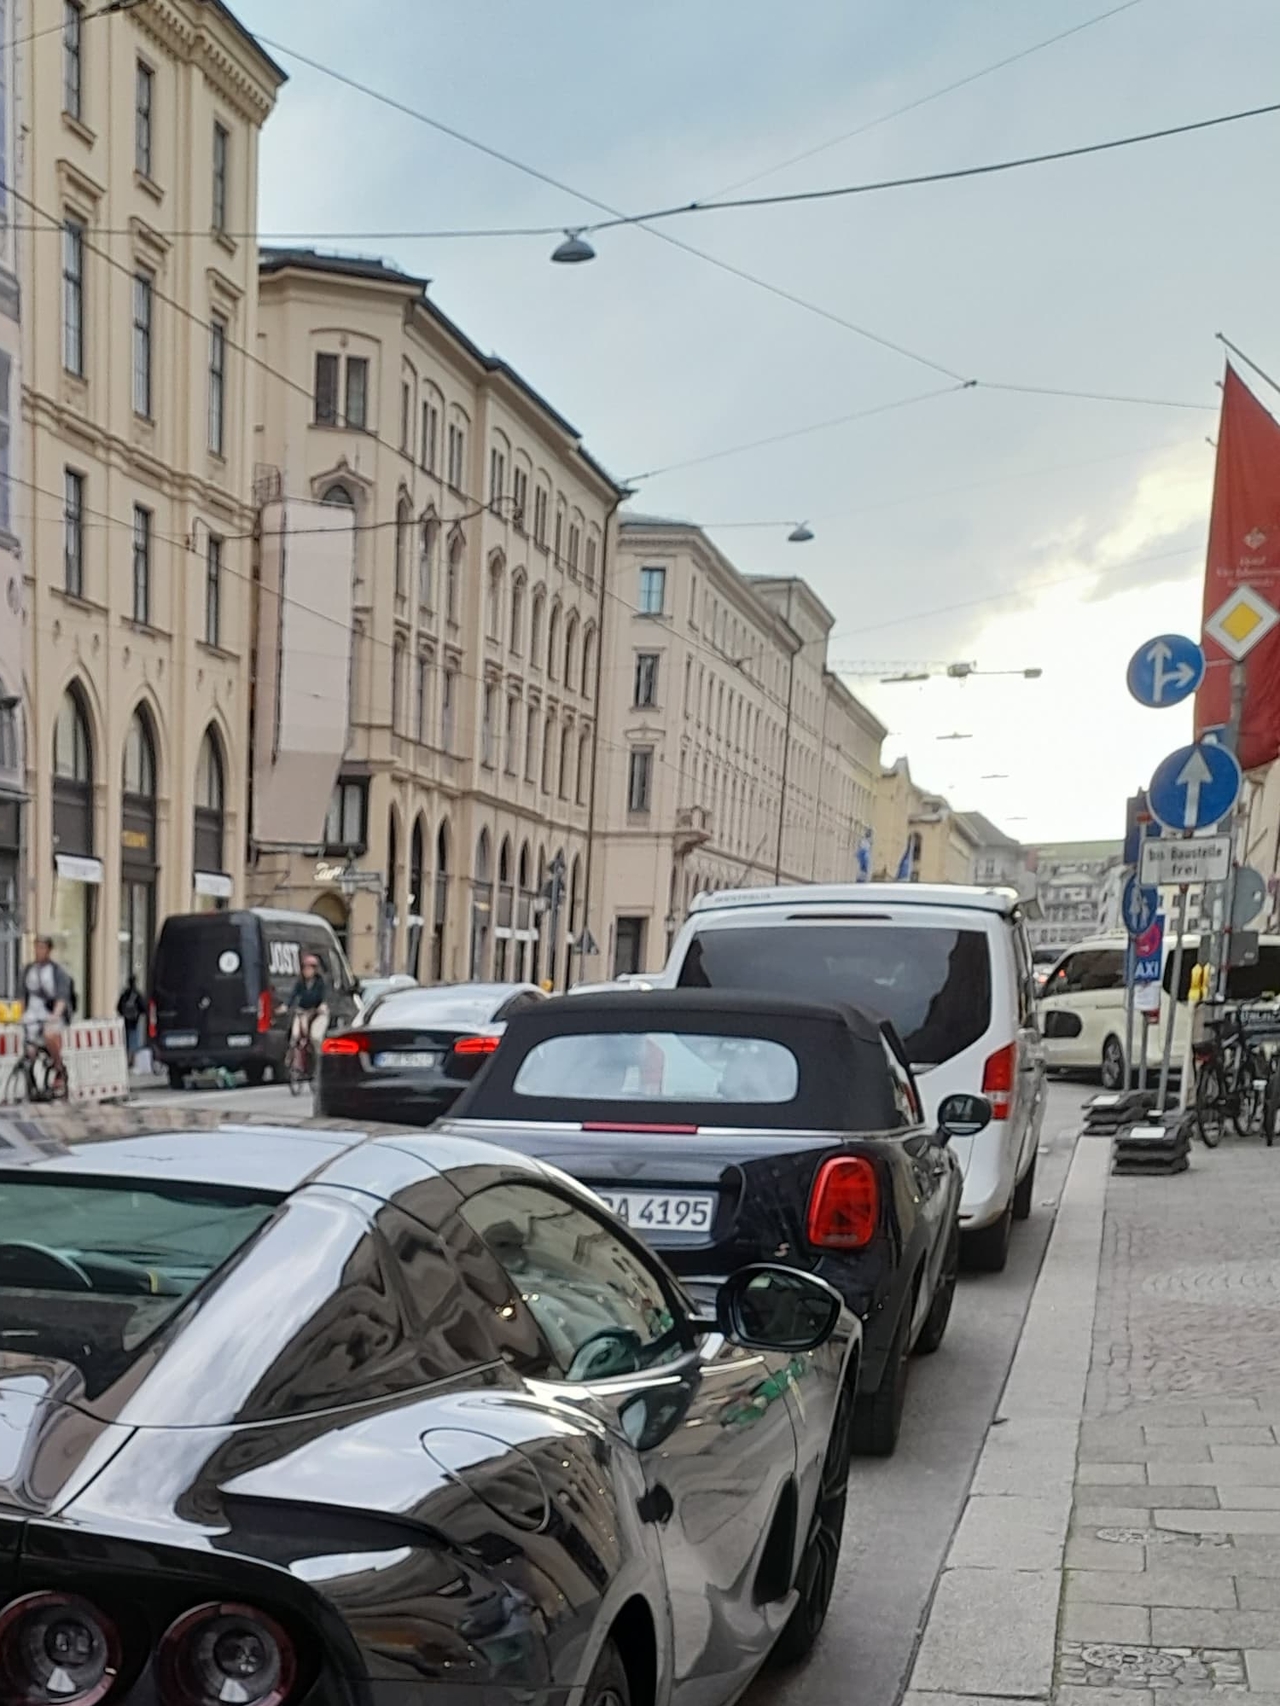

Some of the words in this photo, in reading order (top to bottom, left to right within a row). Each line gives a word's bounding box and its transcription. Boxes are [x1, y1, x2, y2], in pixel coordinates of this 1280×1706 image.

[1170, 844, 1223, 861] Baustelle
[1171, 863, 1198, 876] frei
[1132, 961, 1160, 978] AXI
[639, 1199, 710, 1227] 4195
